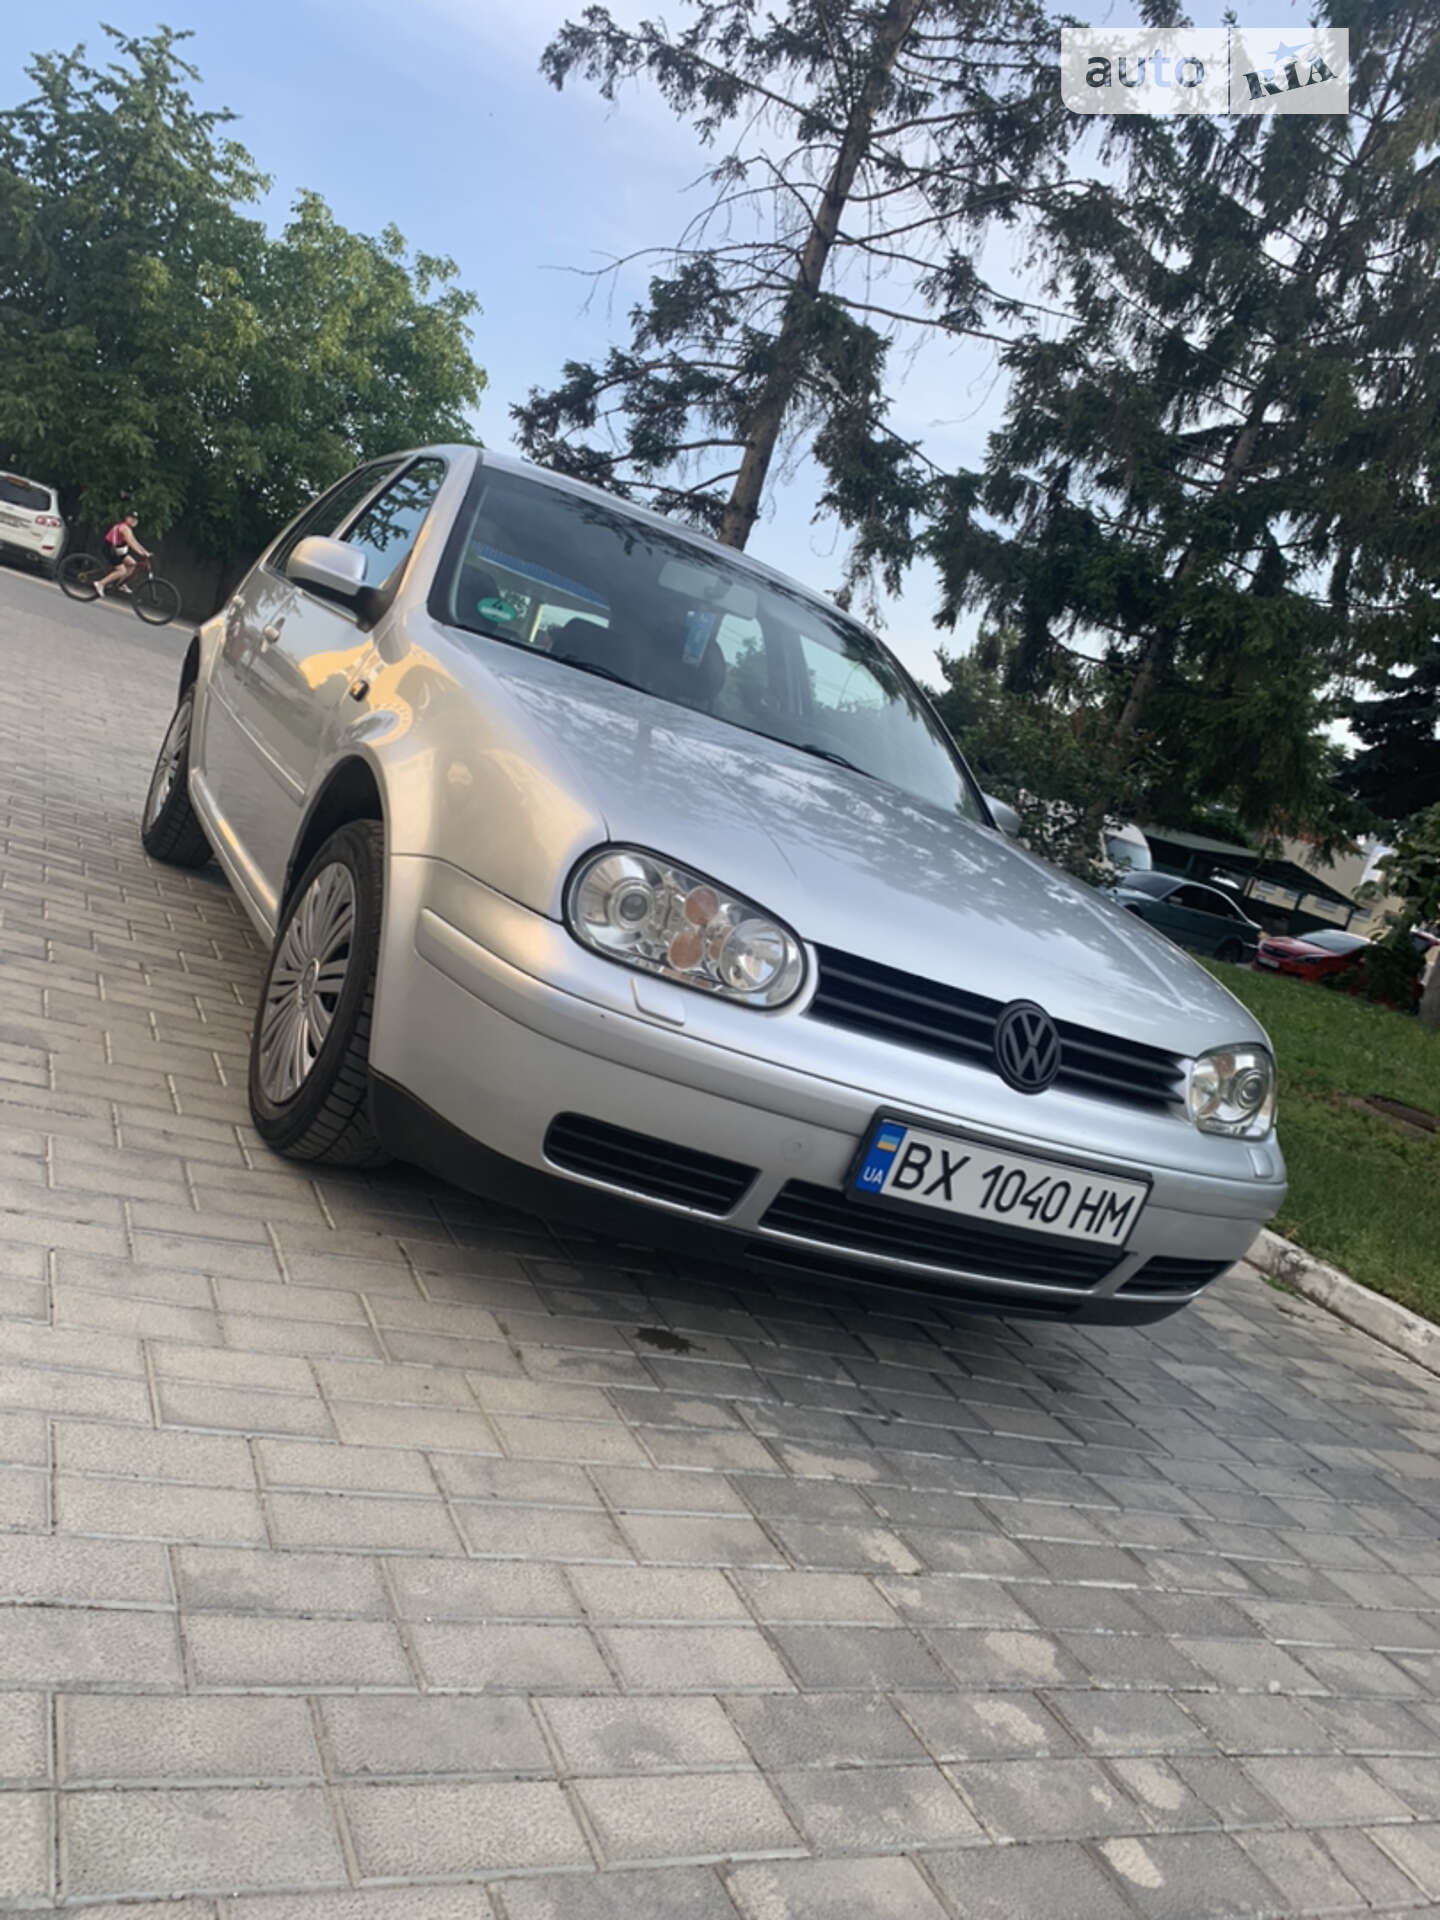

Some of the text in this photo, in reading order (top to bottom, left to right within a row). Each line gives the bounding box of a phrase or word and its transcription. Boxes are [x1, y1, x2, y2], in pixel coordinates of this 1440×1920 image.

[863, 1166, 883, 1185] UA
[892, 1143, 1135, 1237] BX 1040 HM
